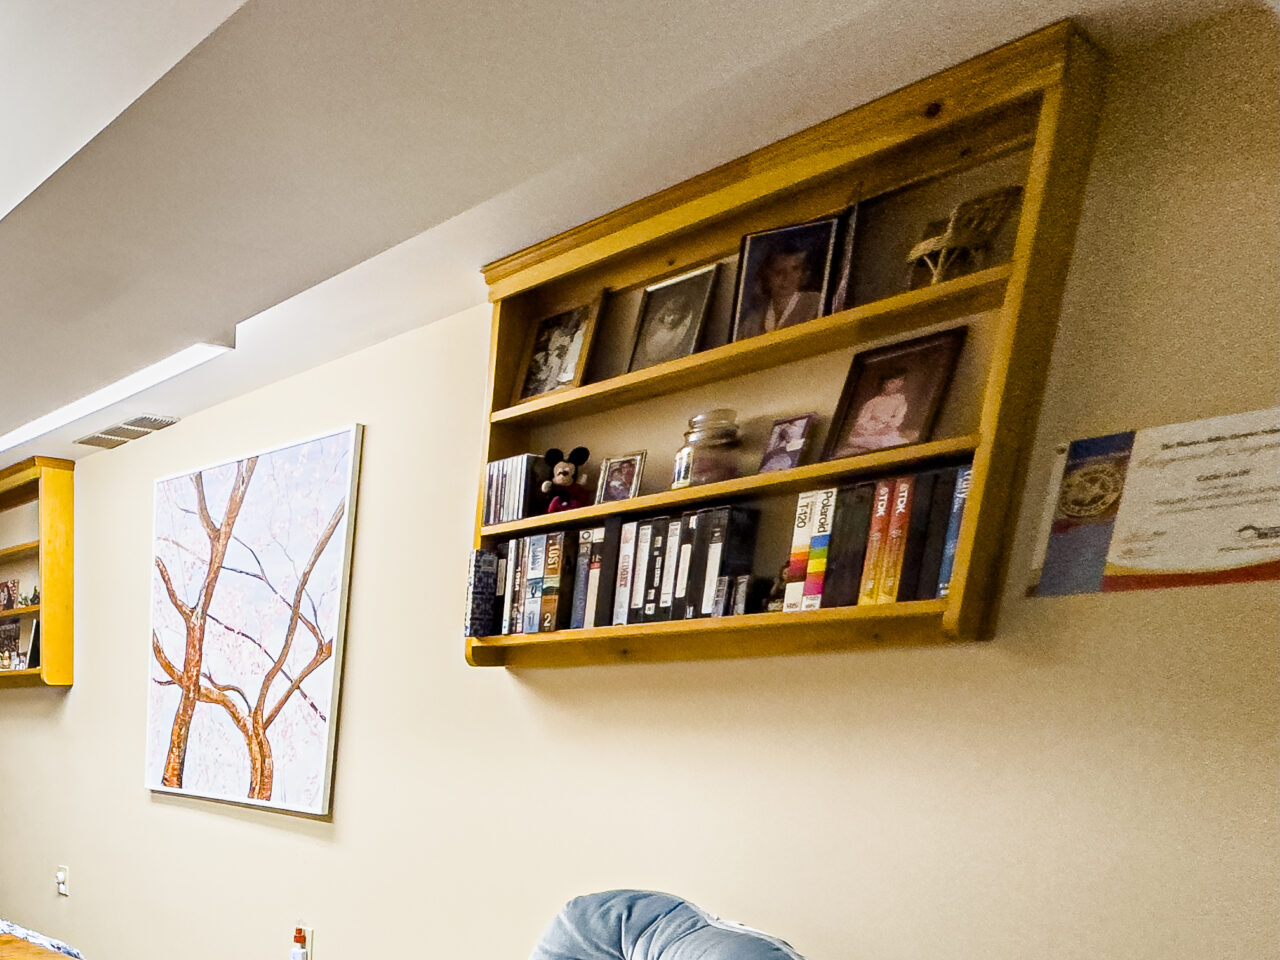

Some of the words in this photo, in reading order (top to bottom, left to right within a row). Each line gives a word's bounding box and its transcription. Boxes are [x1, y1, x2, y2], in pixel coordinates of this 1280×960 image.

[817, 490, 833, 533] Polaroid
[876, 493, 888, 517] TDK
[895, 489, 908, 514] TDK
[797, 502, 808, 528] T-120
[548, 544, 561, 569] LOST
[543, 613, 551, 627] 2
